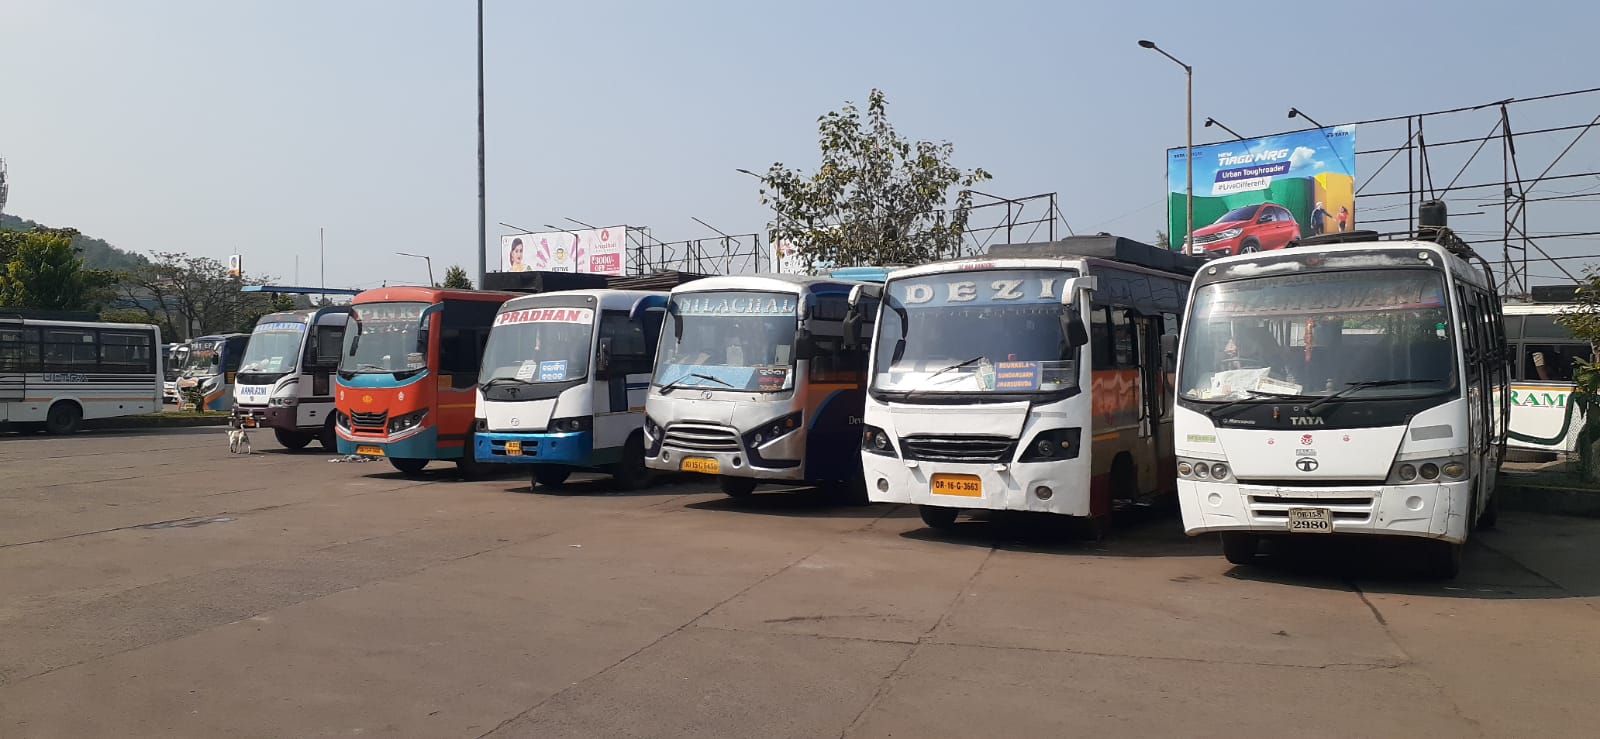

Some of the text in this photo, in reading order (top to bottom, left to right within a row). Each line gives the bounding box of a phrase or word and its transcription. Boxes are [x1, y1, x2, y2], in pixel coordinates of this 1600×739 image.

[1255, 148, 1289, 162] NRG
[1222, 165, 1285, 179] Urban Toughroader
[904, 278, 1057, 305] DEZI
[679, 298, 796, 313] NILACHAL
[501, 309, 582, 324] PRADHAN
[1289, 416, 1325, 425] TATA
[1293, 520, 1328, 530] 2980
